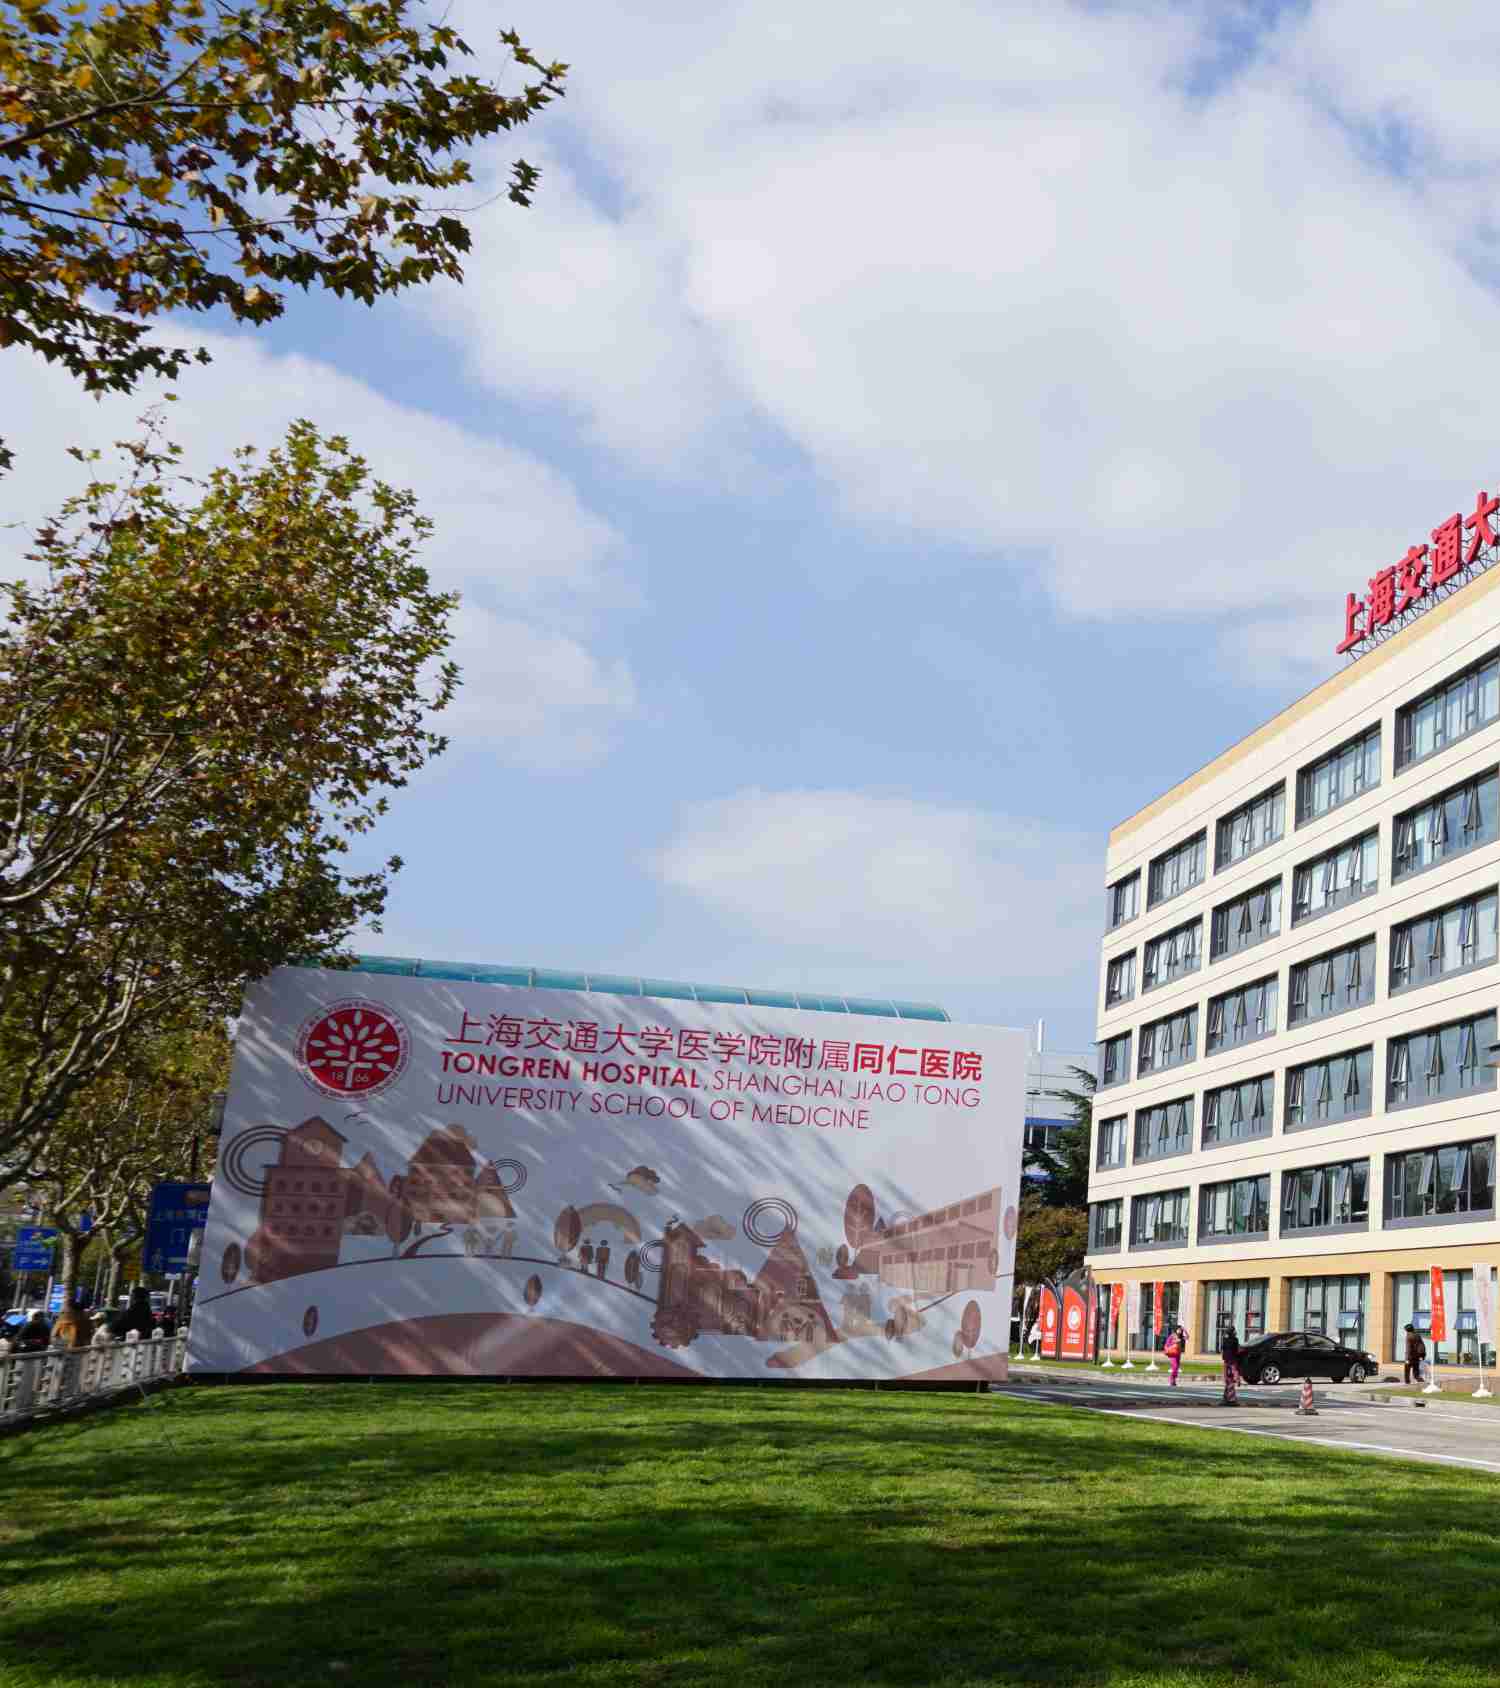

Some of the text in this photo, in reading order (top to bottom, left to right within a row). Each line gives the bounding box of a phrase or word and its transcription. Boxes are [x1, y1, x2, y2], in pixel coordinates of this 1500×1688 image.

[444, 1009, 982, 1081] 上海交通大学医学院附属同仁医院
[437, 1083, 870, 1129] UNIVERSITY SCHOOL OF MEDICINE
[440, 1051, 570, 1080] TONGREN
[712, 1070, 843, 1098] SHANGHAI
[850, 1079, 906, 1103] JIAO
[914, 1084, 981, 1108] TONG
